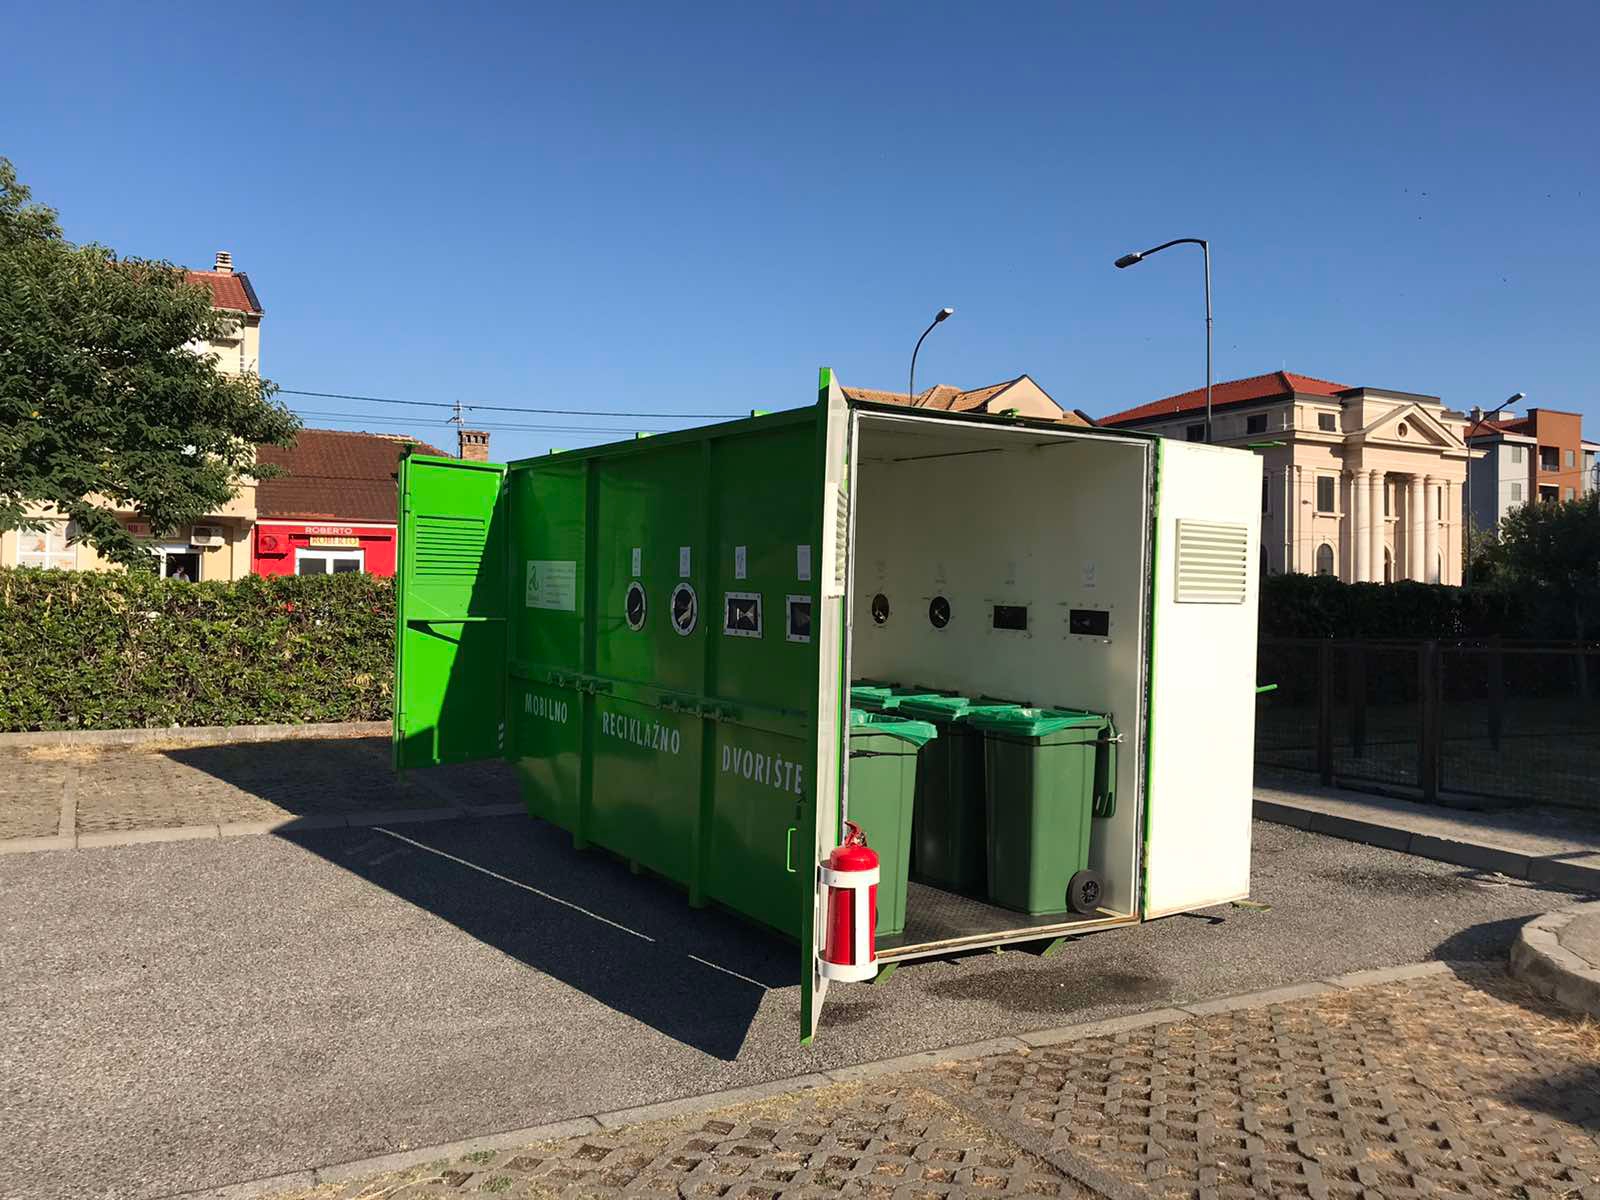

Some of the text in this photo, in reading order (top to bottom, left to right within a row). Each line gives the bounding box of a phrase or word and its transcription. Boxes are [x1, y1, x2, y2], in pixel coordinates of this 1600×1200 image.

[304, 526, 353, 535] ROBERTO
[525, 692, 803, 794] MOBILNO RECIKLAŽNO DVORIŠTE
